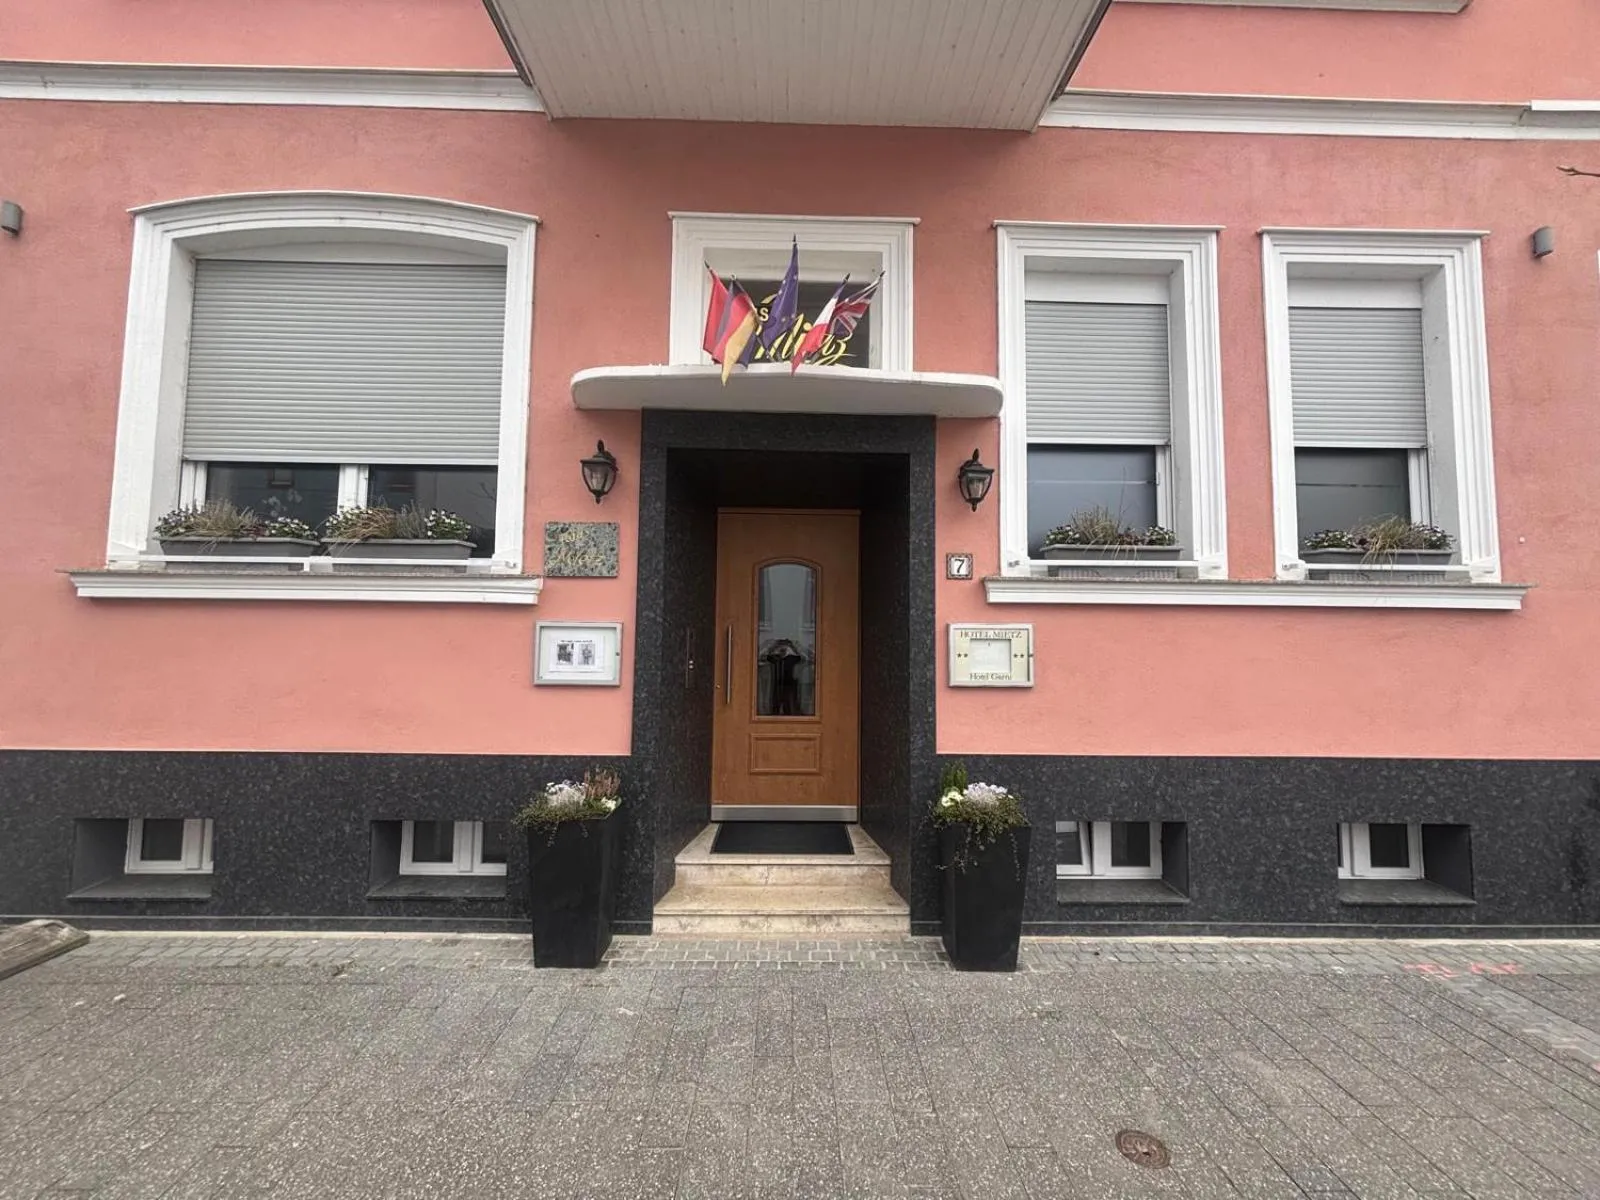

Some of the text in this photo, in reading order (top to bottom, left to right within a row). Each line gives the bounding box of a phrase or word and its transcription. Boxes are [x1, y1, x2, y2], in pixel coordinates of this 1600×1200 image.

[954, 558, 965, 574] 7
[960, 631, 991, 639] HOTEL
[970, 672, 988, 681] Hotel
